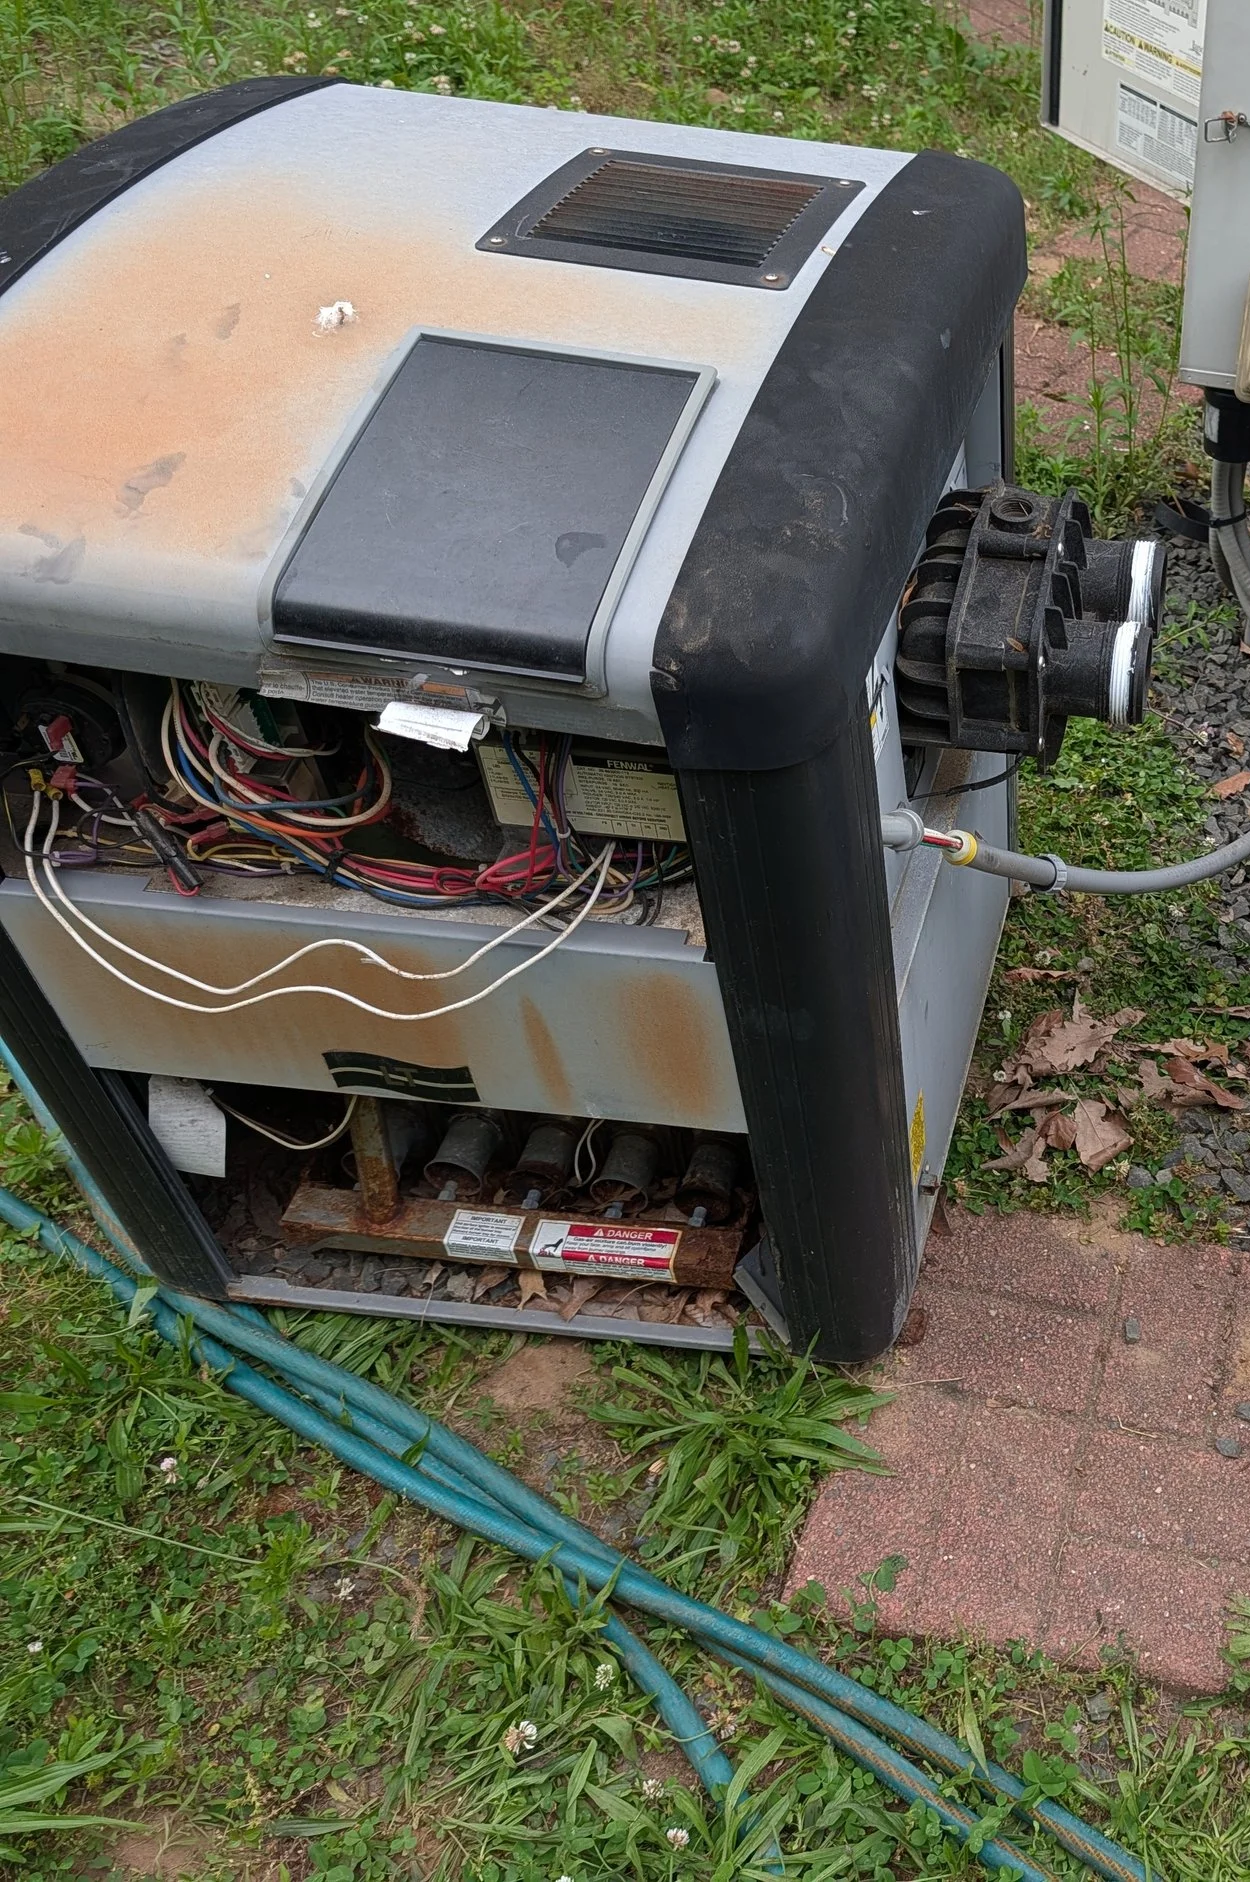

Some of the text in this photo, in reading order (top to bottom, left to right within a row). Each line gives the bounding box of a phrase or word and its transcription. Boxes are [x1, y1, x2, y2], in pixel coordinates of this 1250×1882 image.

[1109, 24, 1136, 46] CAUTION
[1143, 40, 1173, 64] WARNING
[379, 1064, 418, 1088] LT
[470, 1215, 508, 1224] IMPORTANT
[462, 1235, 499, 1244] IMPORTANT
[606, 1229, 653, 1240] DANGER
[600, 1255, 645, 1267] DANGER
